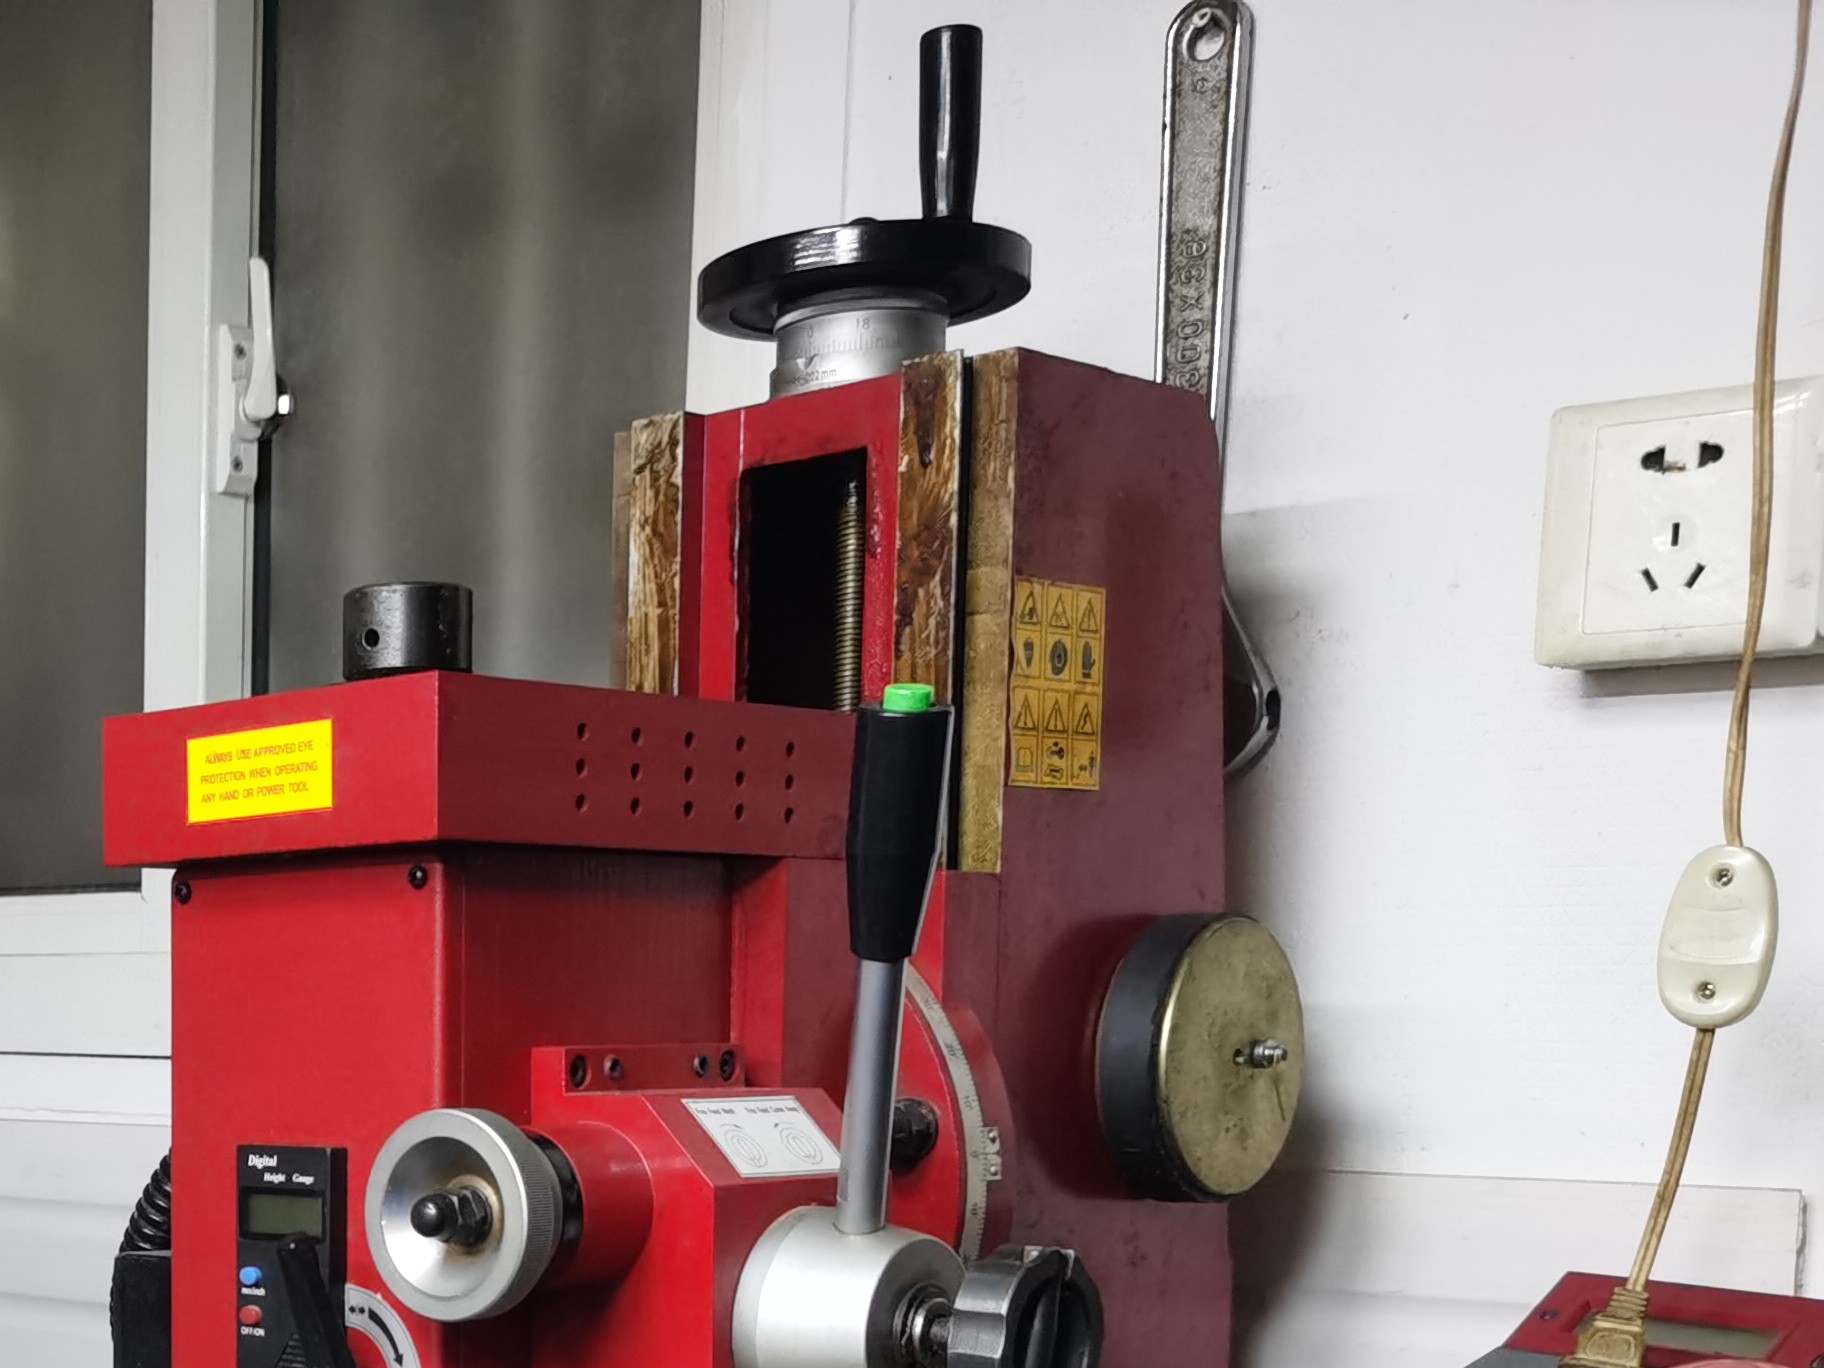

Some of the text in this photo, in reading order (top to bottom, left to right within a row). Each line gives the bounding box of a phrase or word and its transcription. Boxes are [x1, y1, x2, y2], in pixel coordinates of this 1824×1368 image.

[205, 740, 314, 765] ALWAYS USE APPROVED EYE
[200, 761, 318, 785] PROTECTION WHEN OPERATING
[201, 781, 309, 804] ANY HAND OR POWER TOOL
[248, 1154, 278, 1169] Digital
[263, 1172, 315, 1186] Height Gauge
